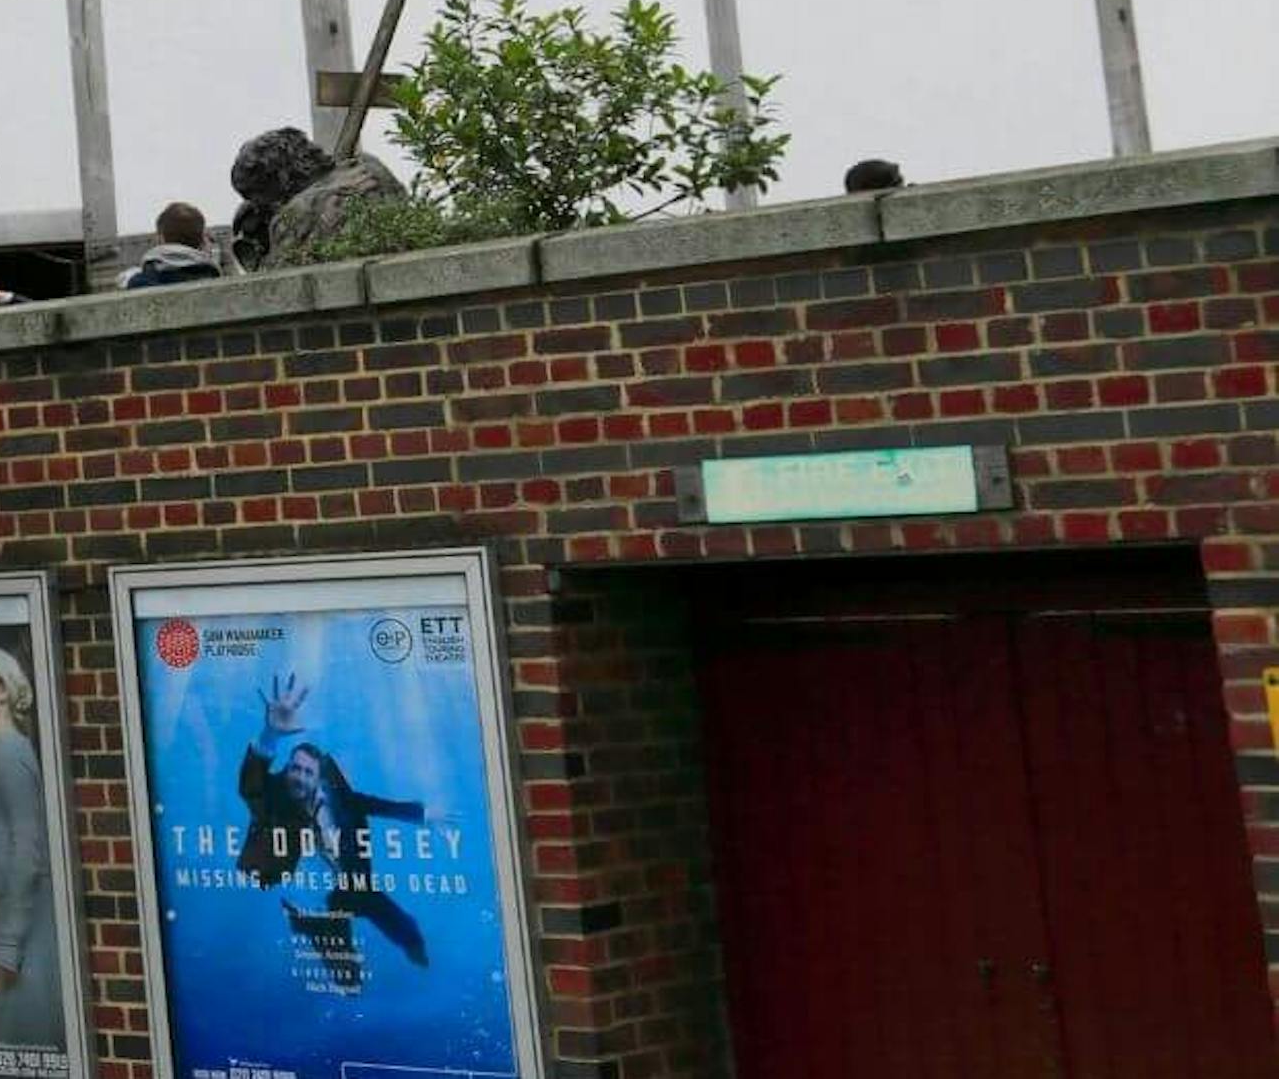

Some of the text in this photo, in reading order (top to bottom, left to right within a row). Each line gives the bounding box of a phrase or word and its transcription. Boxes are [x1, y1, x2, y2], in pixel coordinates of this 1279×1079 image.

[420, 616, 463, 634] ETT
[172, 824, 462, 861] THE ODYSSEY
[176, 869, 469, 895] MISSING, PRESUMED DEAD
